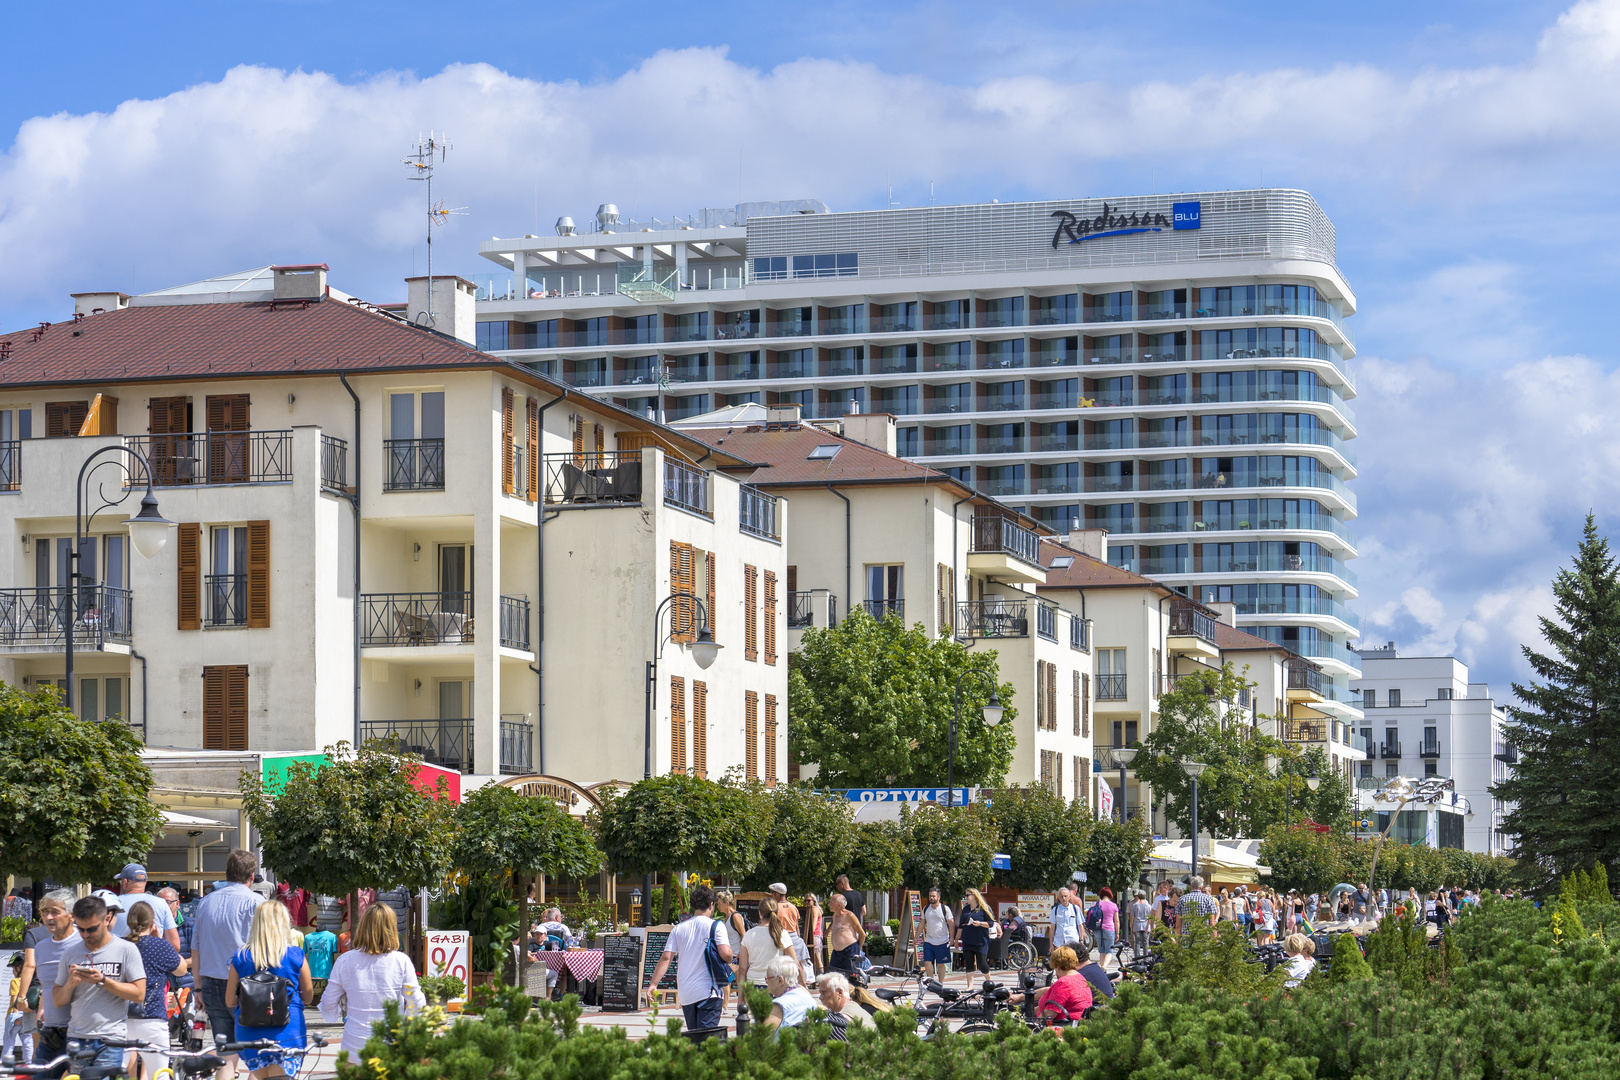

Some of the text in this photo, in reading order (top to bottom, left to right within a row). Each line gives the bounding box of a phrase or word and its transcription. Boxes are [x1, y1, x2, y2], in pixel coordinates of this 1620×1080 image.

[1175, 213, 1199, 221] BLU
[1051, 201, 1170, 250] Radisson
[522, 783, 572, 804] AMSTERDAM
[860, 790, 930, 802] OPTYK
[430, 934, 465, 944] GABI
